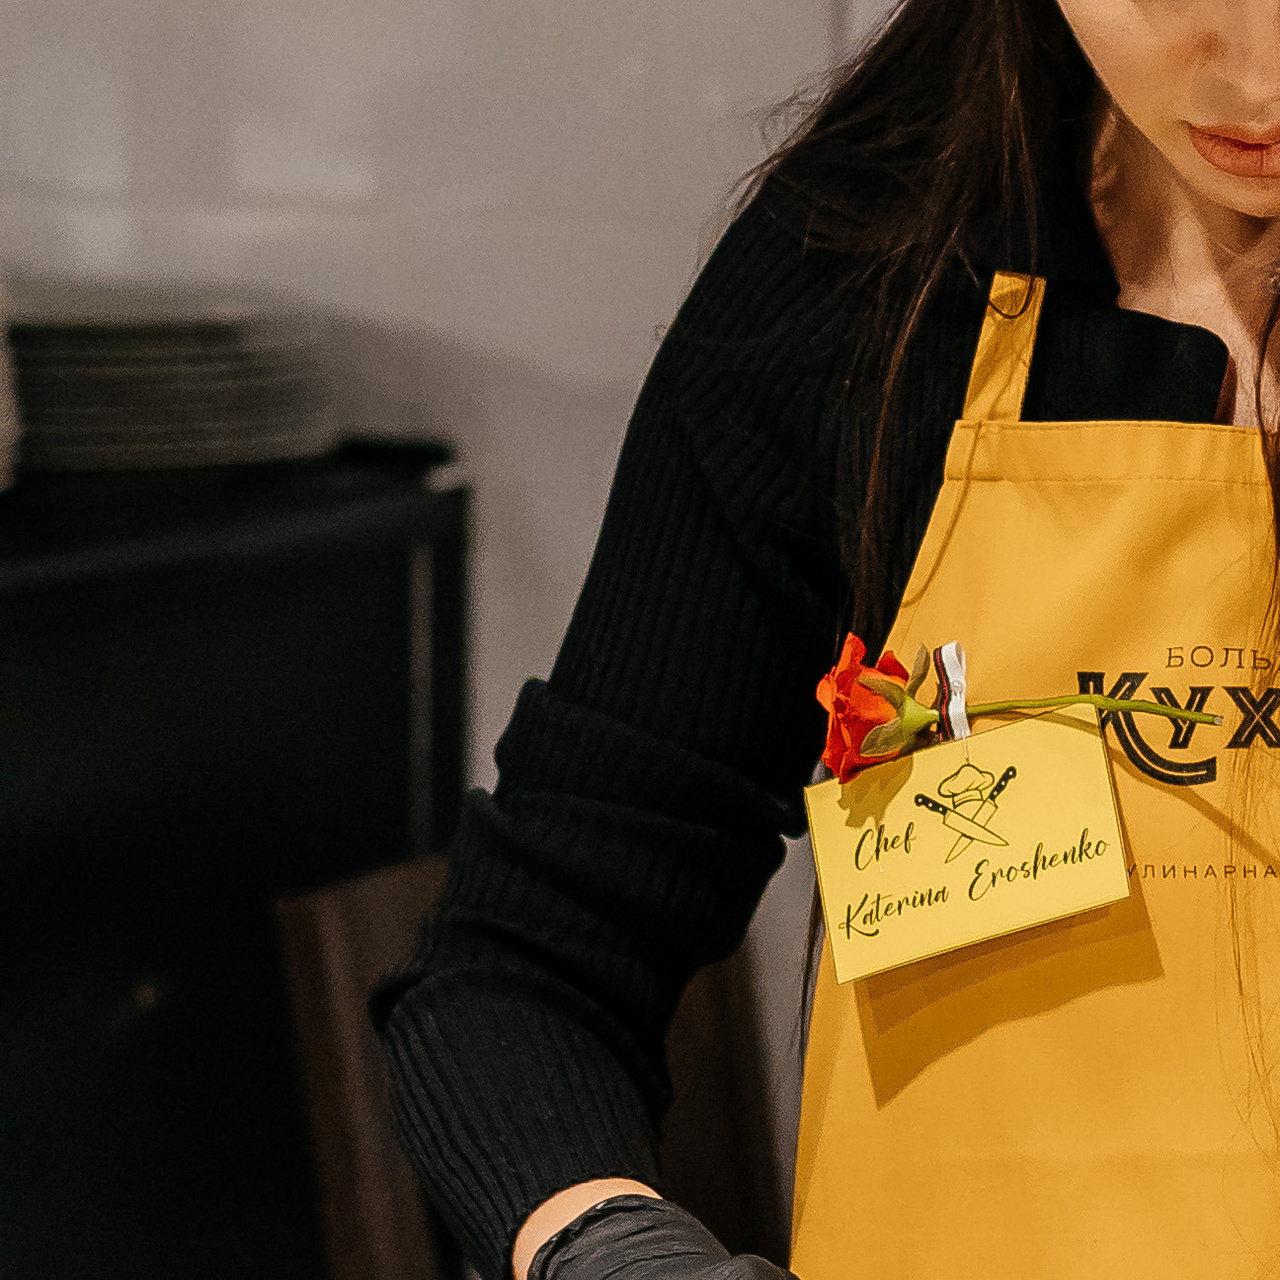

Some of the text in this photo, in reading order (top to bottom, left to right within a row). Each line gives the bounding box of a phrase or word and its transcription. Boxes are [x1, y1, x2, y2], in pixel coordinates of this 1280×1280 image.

[838, 827, 1110, 940] Katerina Eroshenko
[854, 821, 917, 871] Chef
